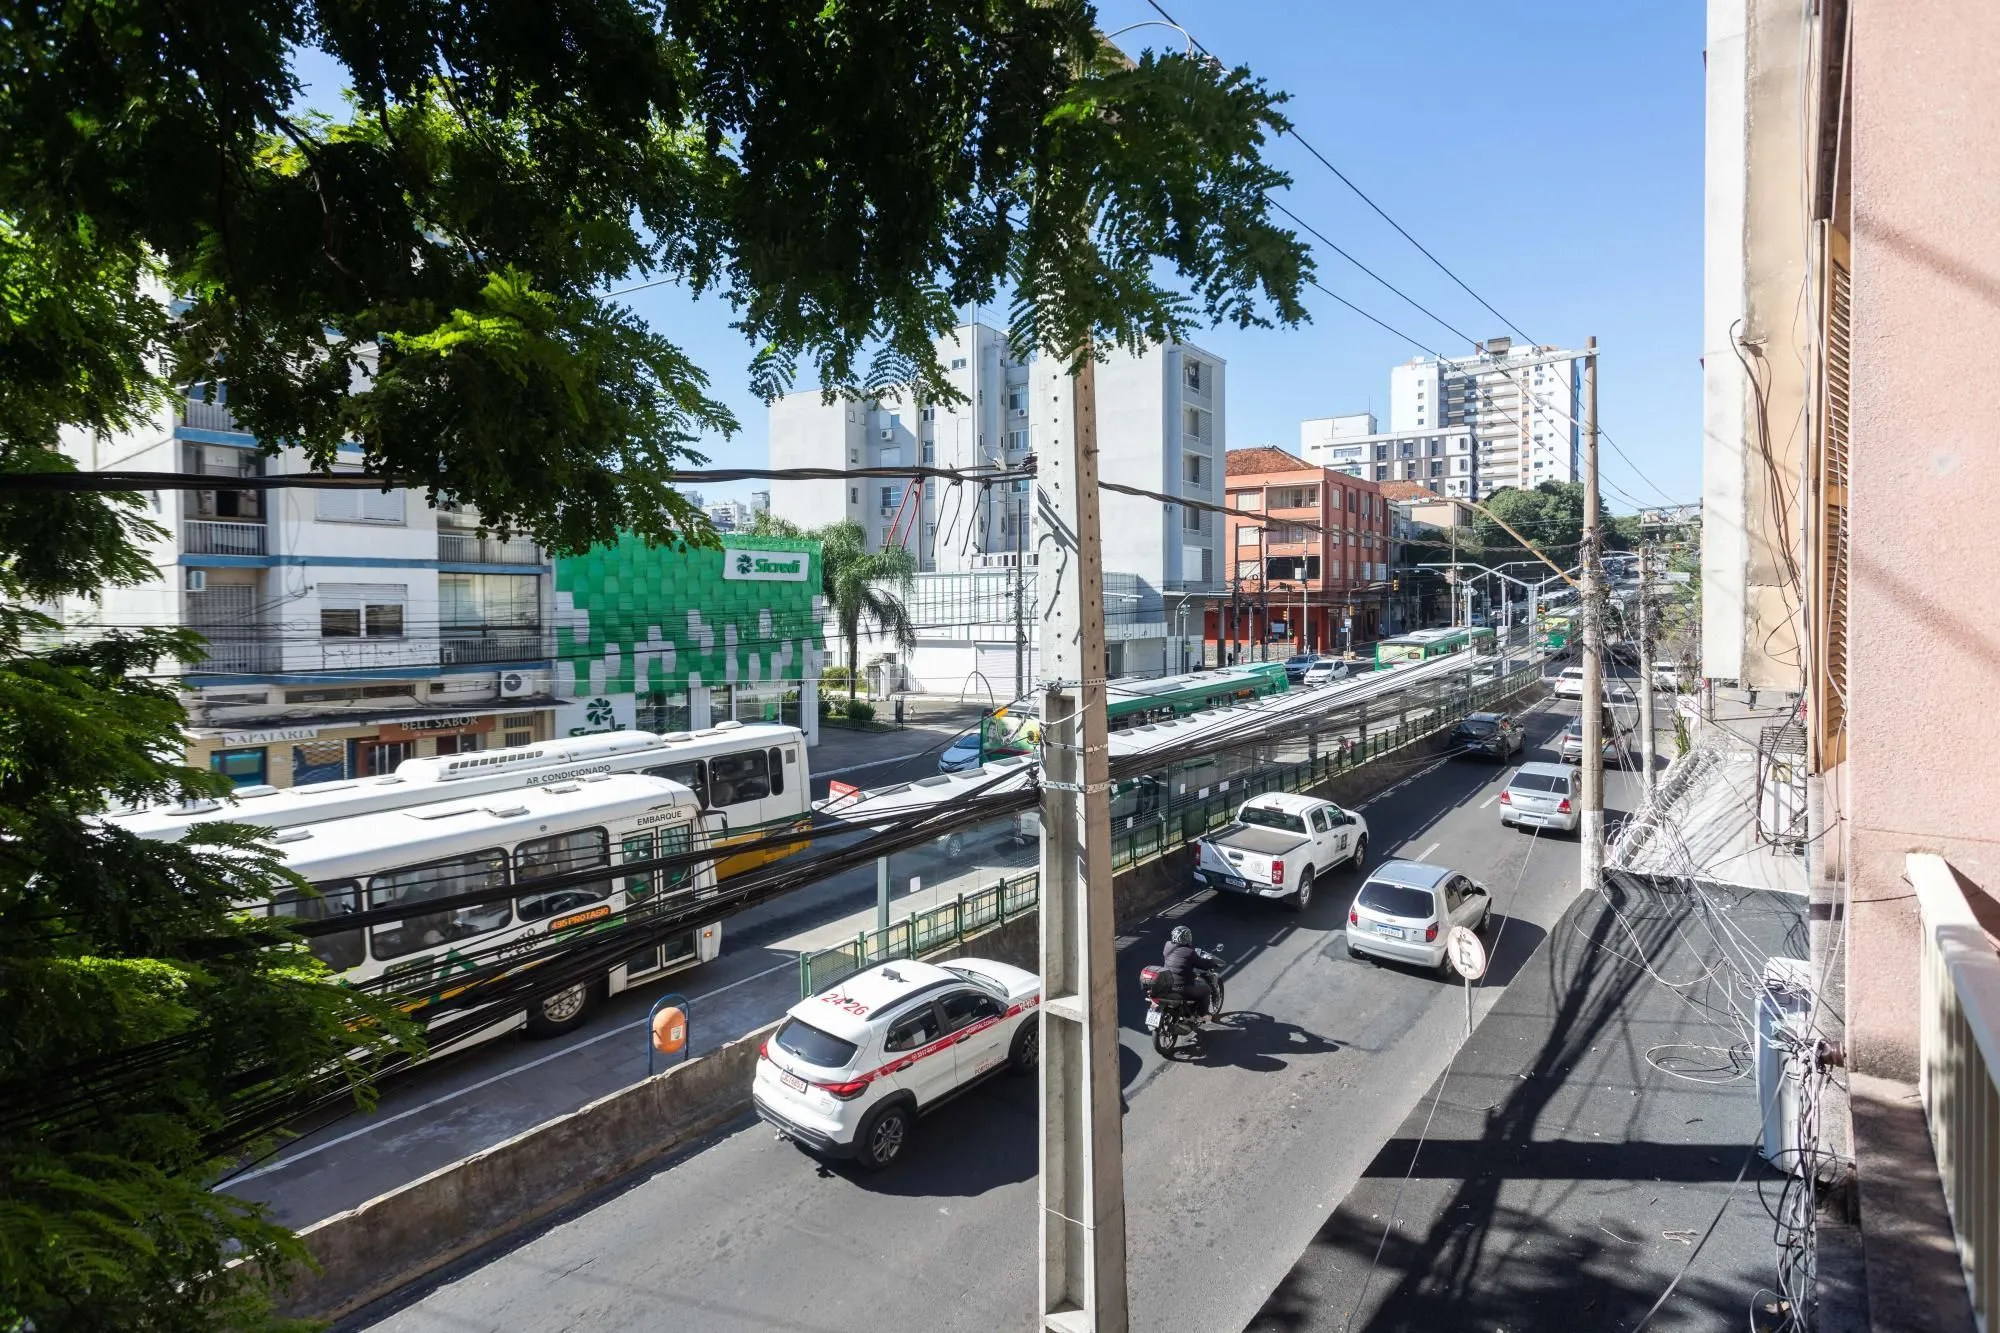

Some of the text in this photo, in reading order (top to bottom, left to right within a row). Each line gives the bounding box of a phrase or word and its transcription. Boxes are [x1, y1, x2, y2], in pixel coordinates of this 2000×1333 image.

[755, 559, 801, 573] Sicredi
[401, 716, 480, 731] BELL SABOR
[526, 764, 611, 785] AR CONDICIONADO
[637, 810, 683, 826] EMBARQUE
